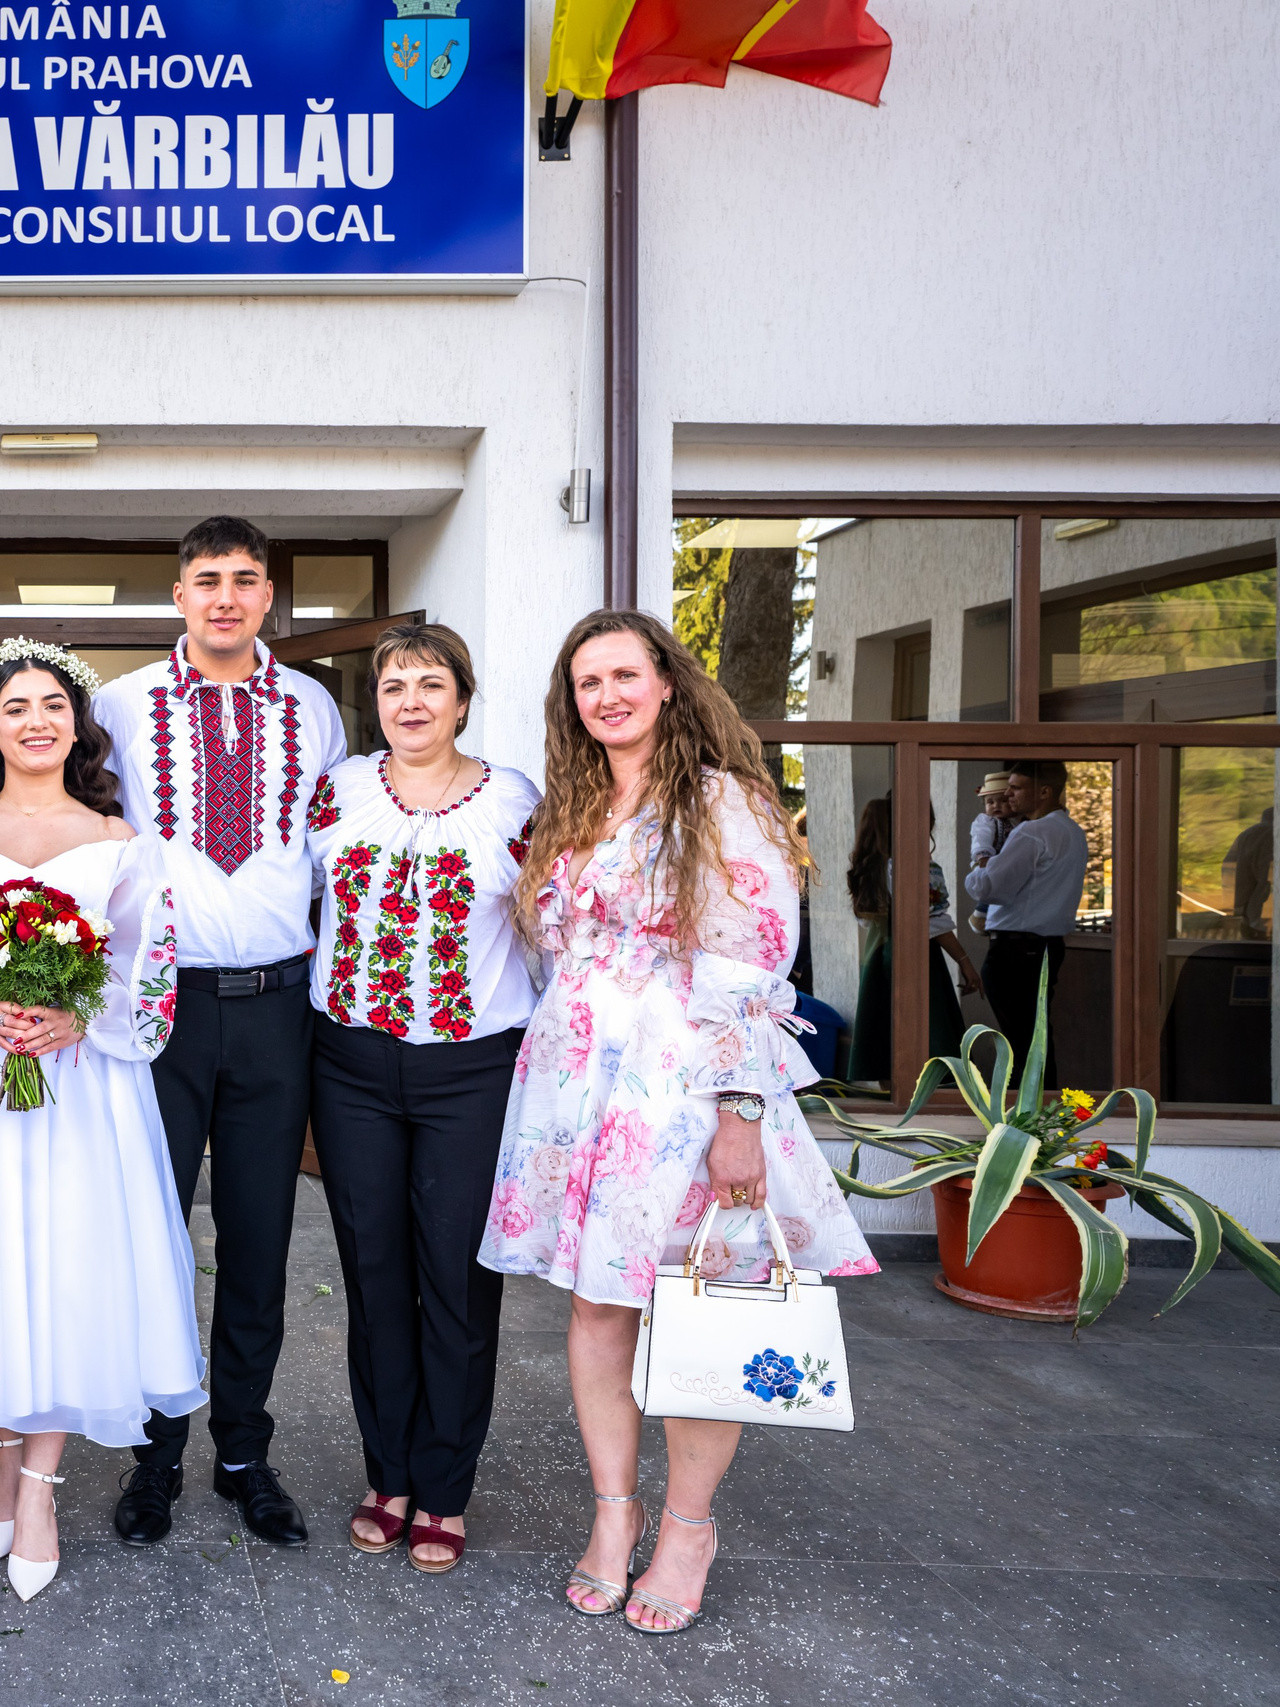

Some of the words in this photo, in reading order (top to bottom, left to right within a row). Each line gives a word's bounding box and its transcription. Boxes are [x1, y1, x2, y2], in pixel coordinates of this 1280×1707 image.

[43, 54, 253, 90] PRAHOVA
[33, 98, 394, 191] VĂRBILĂU
[245, 204, 396, 243] LOCAL
